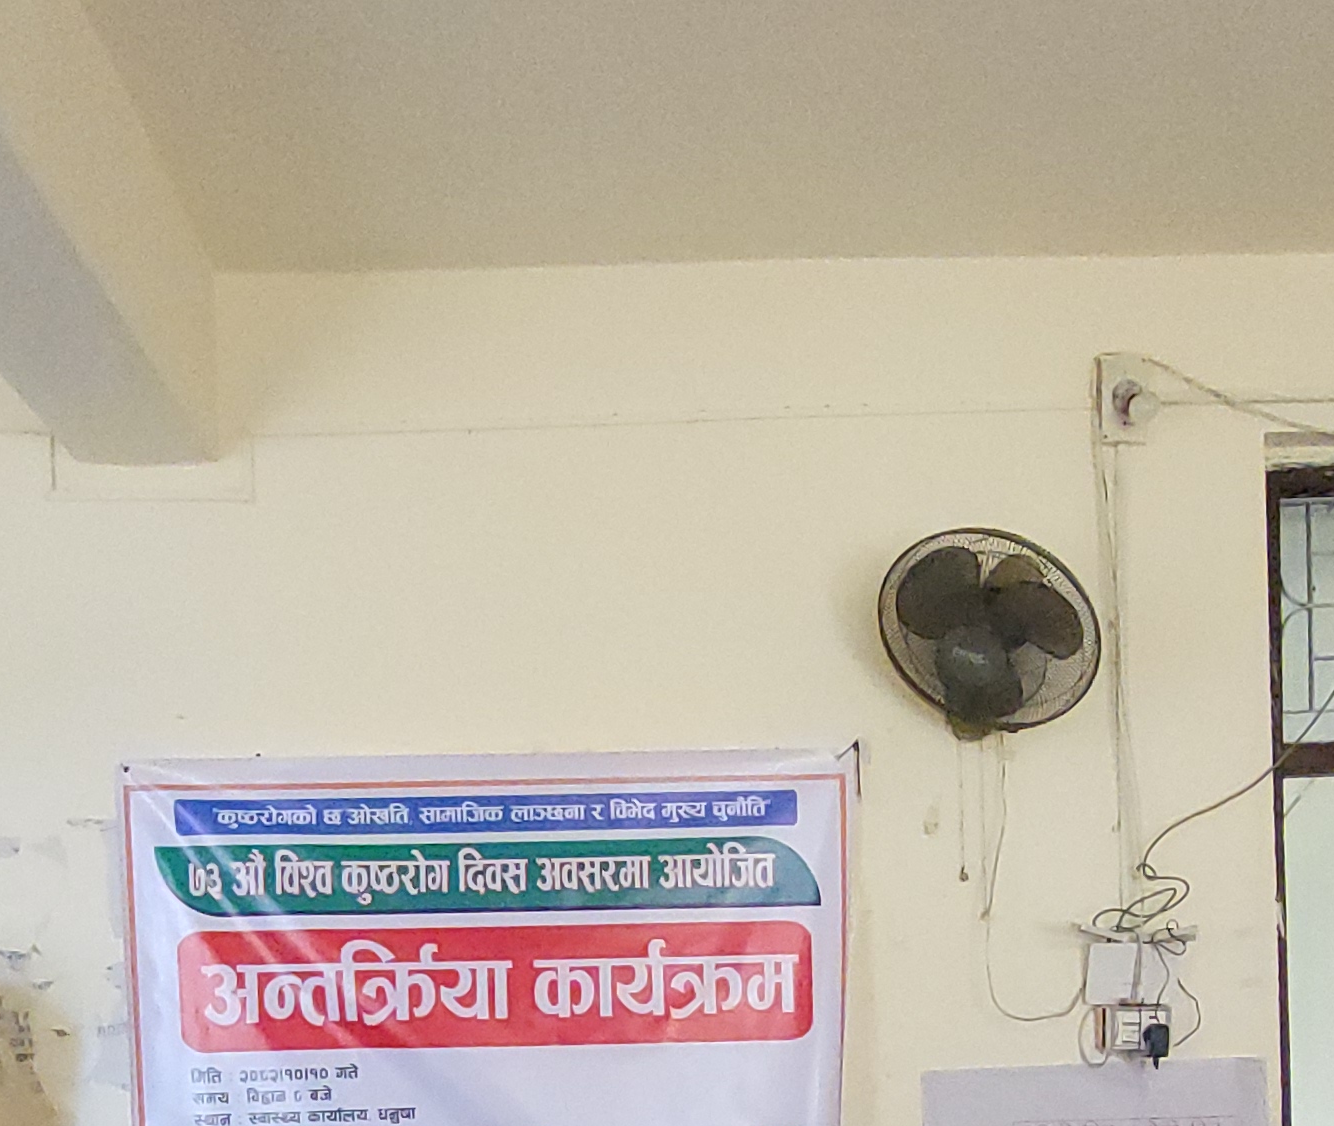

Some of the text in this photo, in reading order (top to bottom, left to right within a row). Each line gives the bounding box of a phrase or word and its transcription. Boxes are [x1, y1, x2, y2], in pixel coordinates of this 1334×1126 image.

[323, 808, 342, 825] छ
[419, 801, 505, 824] सामाजिक
[590, 804, 605, 820] र
[188, 861, 223, 900] ७३
[274, 849, 335, 898] विश्व
[341, 849, 451, 906] कुष्ठरोग
[457, 847, 529, 895] दिवस
[536, 855, 652, 893] अवसरमा
[658, 841, 776, 889] आयोजित
[533, 938, 799, 1019] कार्यक्रम
[335, 1063, 359, 1079] गते
